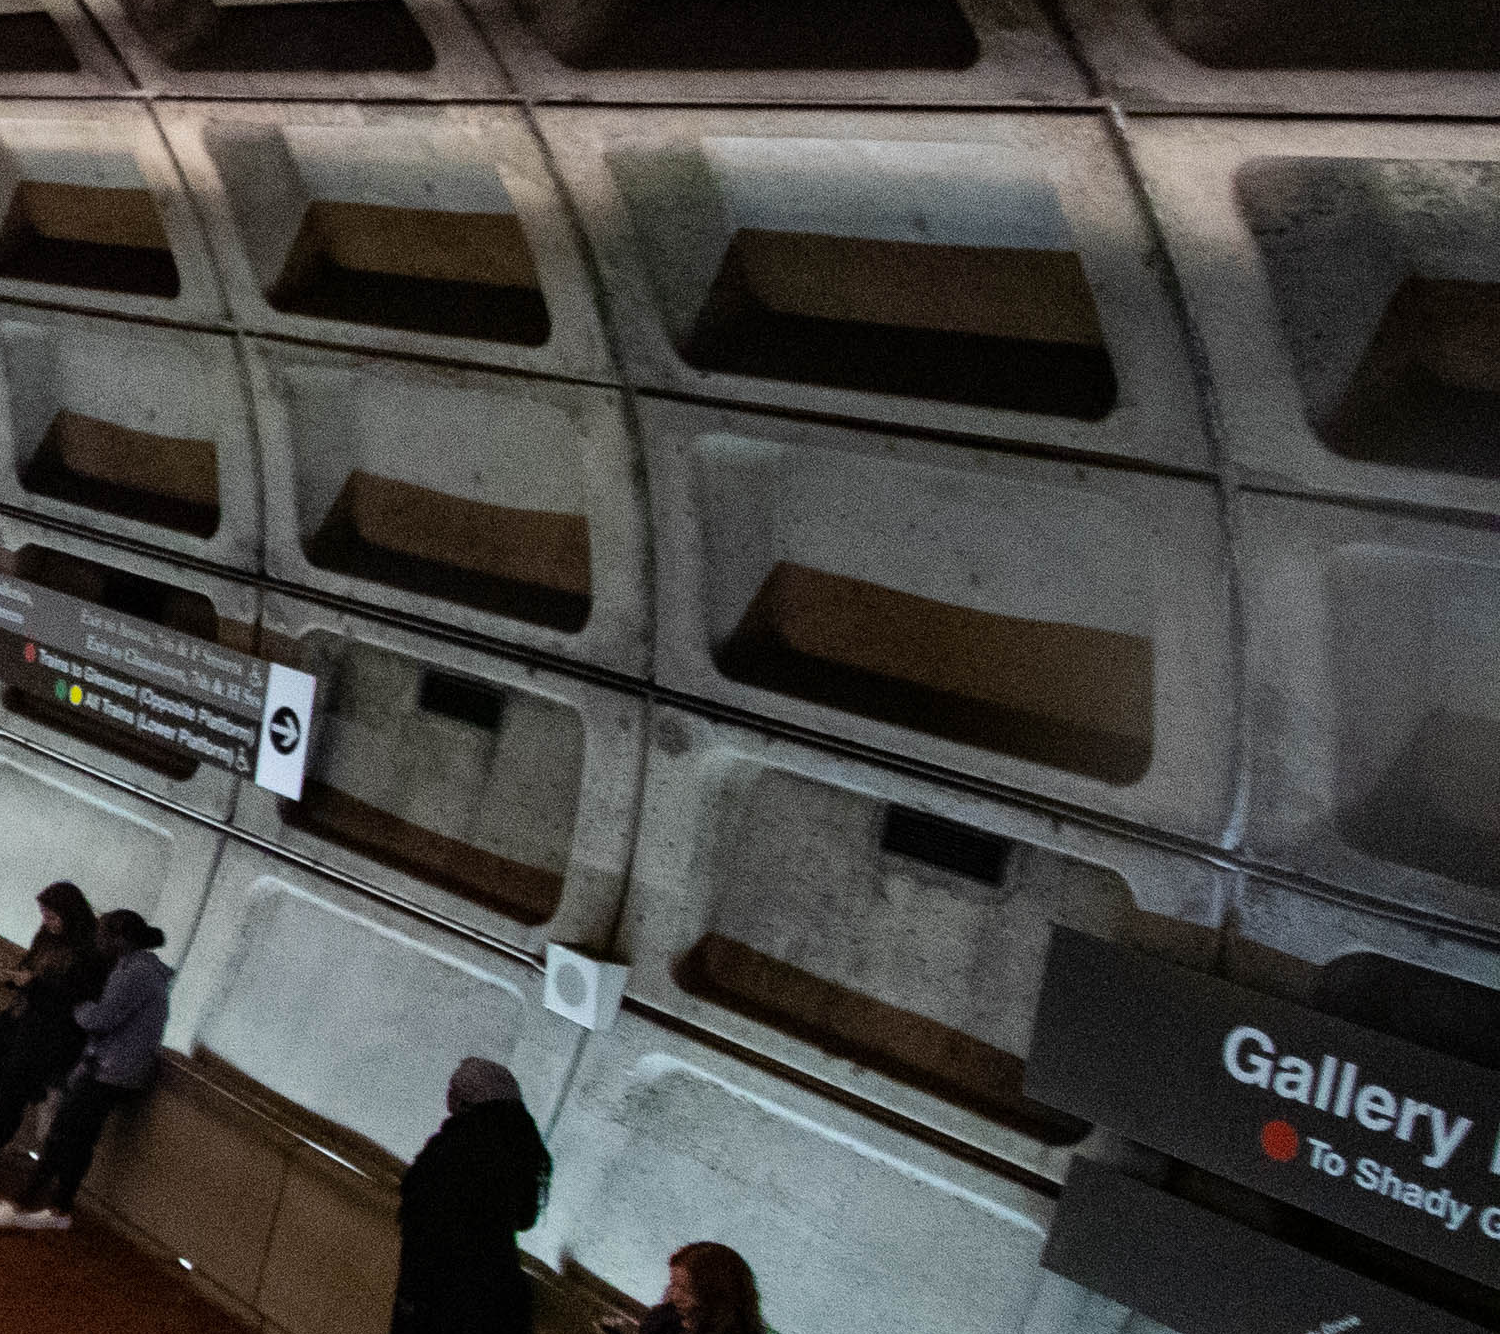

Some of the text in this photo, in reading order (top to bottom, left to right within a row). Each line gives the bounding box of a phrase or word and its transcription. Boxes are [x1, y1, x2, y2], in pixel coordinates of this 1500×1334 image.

[1223, 1025, 1474, 1169] Gallery
[1306, 1136, 1348, 1177] To
[1353, 1157, 1472, 1231] Shady
